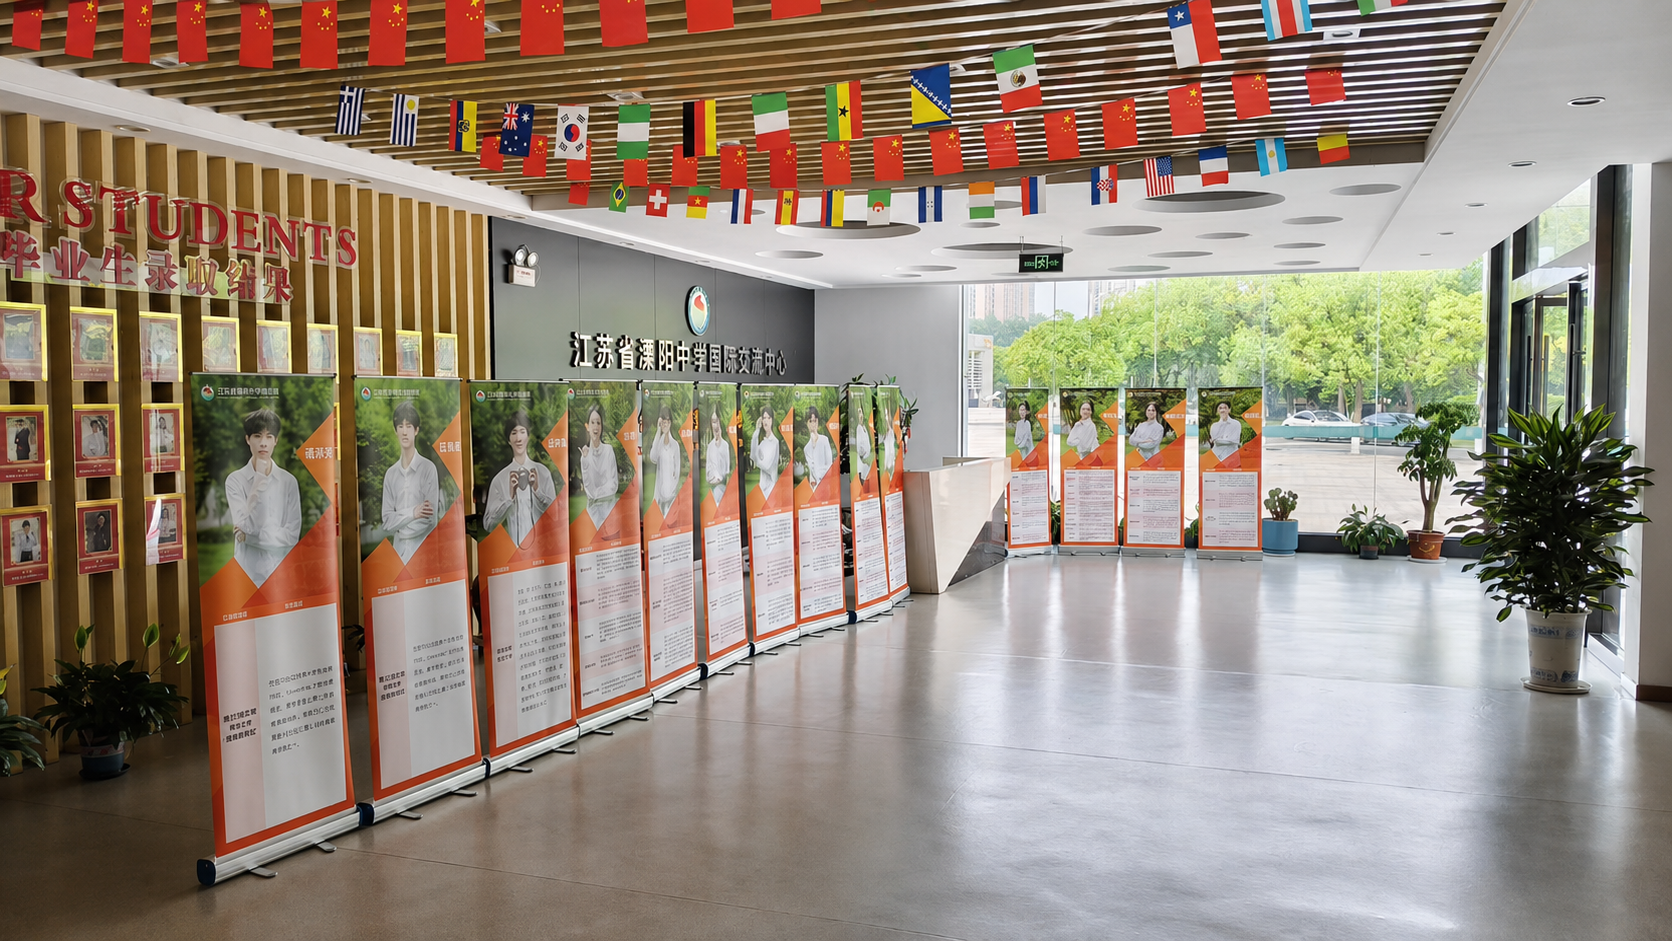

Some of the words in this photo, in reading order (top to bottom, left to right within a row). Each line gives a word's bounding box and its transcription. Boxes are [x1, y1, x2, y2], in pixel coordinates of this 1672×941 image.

[63, 181, 357, 267] STUDENTS
[572, 331, 788, 377] 江苏省溧阳中学国际交流中心
